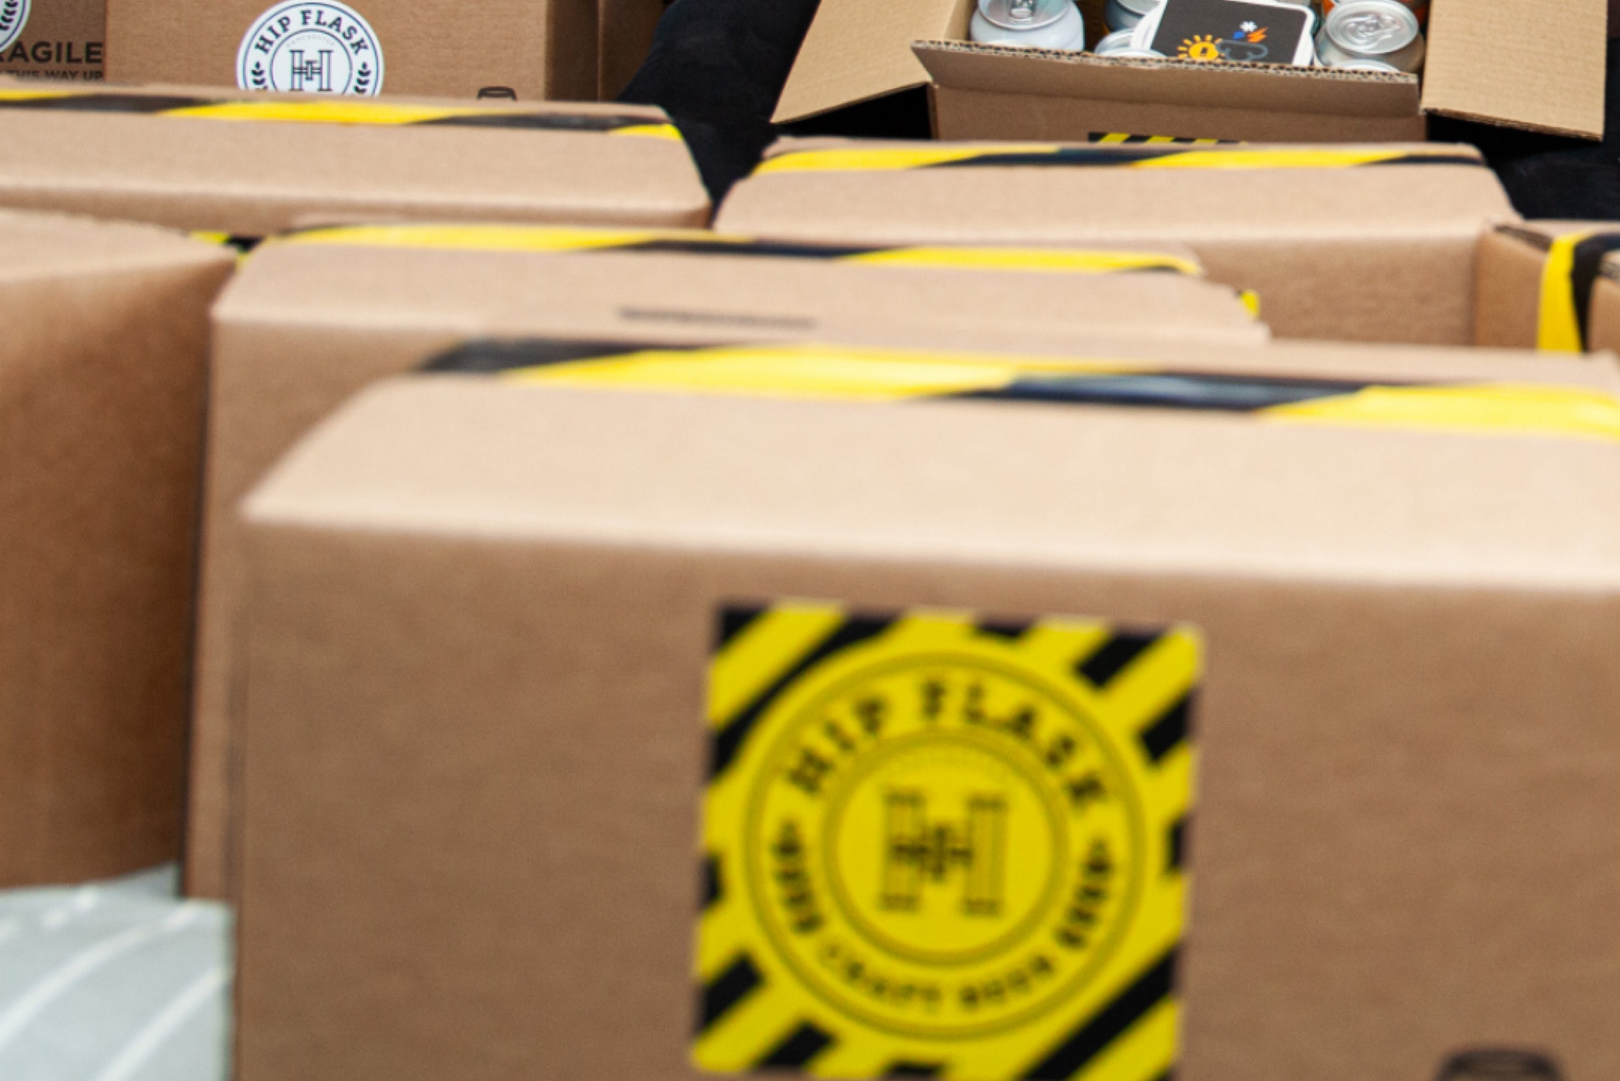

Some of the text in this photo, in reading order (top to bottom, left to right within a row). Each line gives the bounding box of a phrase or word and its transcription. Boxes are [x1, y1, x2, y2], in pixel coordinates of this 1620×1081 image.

[254, 9, 369, 55] HIP FLASK
[0, 41, 104, 65] AGILE
[44, 70, 79, 82] WAY
[83, 70, 104, 82] UP
[786, 676, 1108, 816] HIP FLASK
